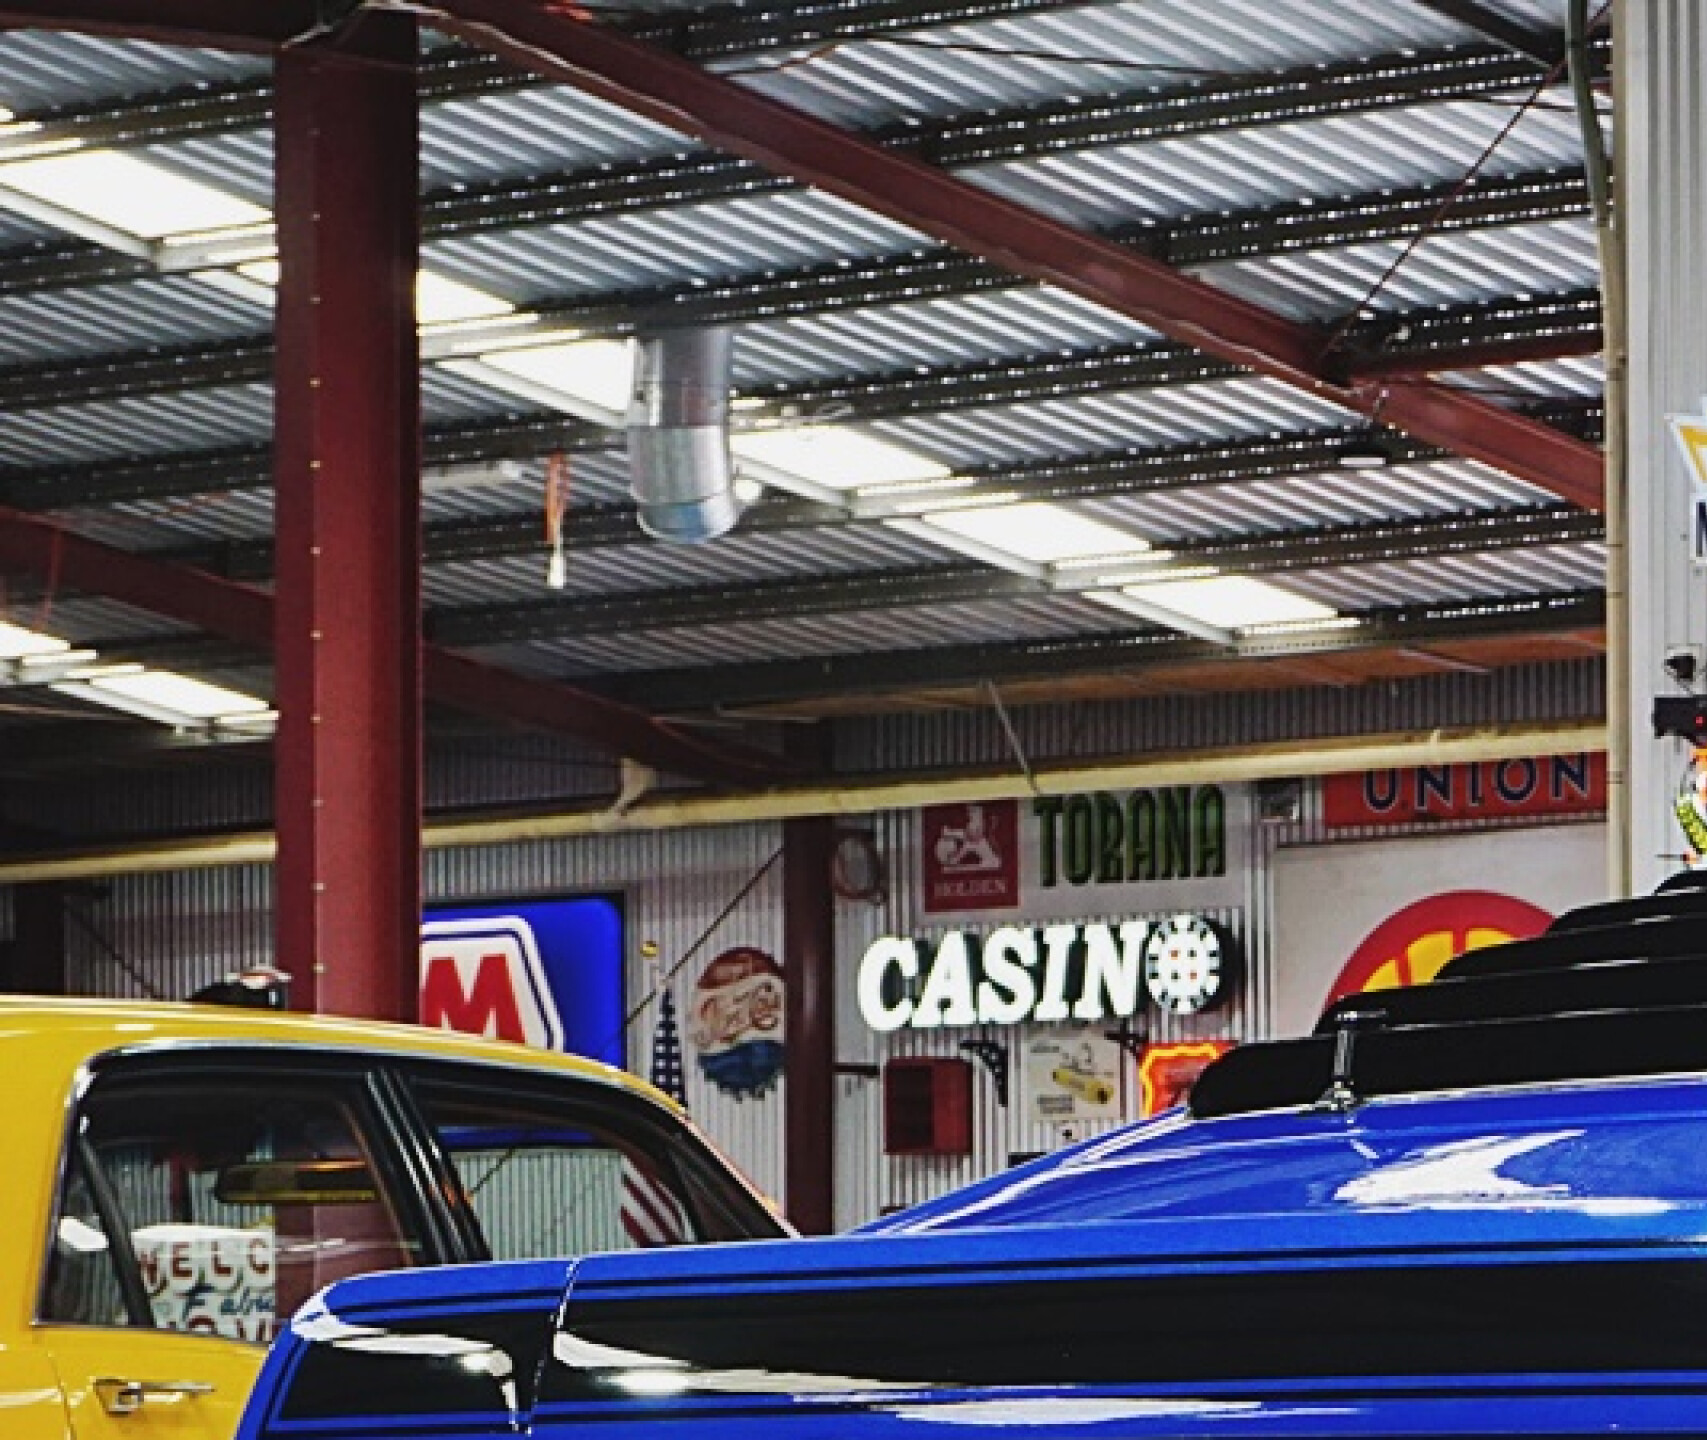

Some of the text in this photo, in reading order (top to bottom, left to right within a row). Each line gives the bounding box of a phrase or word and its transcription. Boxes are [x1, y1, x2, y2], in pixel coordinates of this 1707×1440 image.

[1362, 752, 1591, 814] UNION
[1032, 785, 1227, 888] TORANA
[933, 880, 1009, 899] HOLDEN
